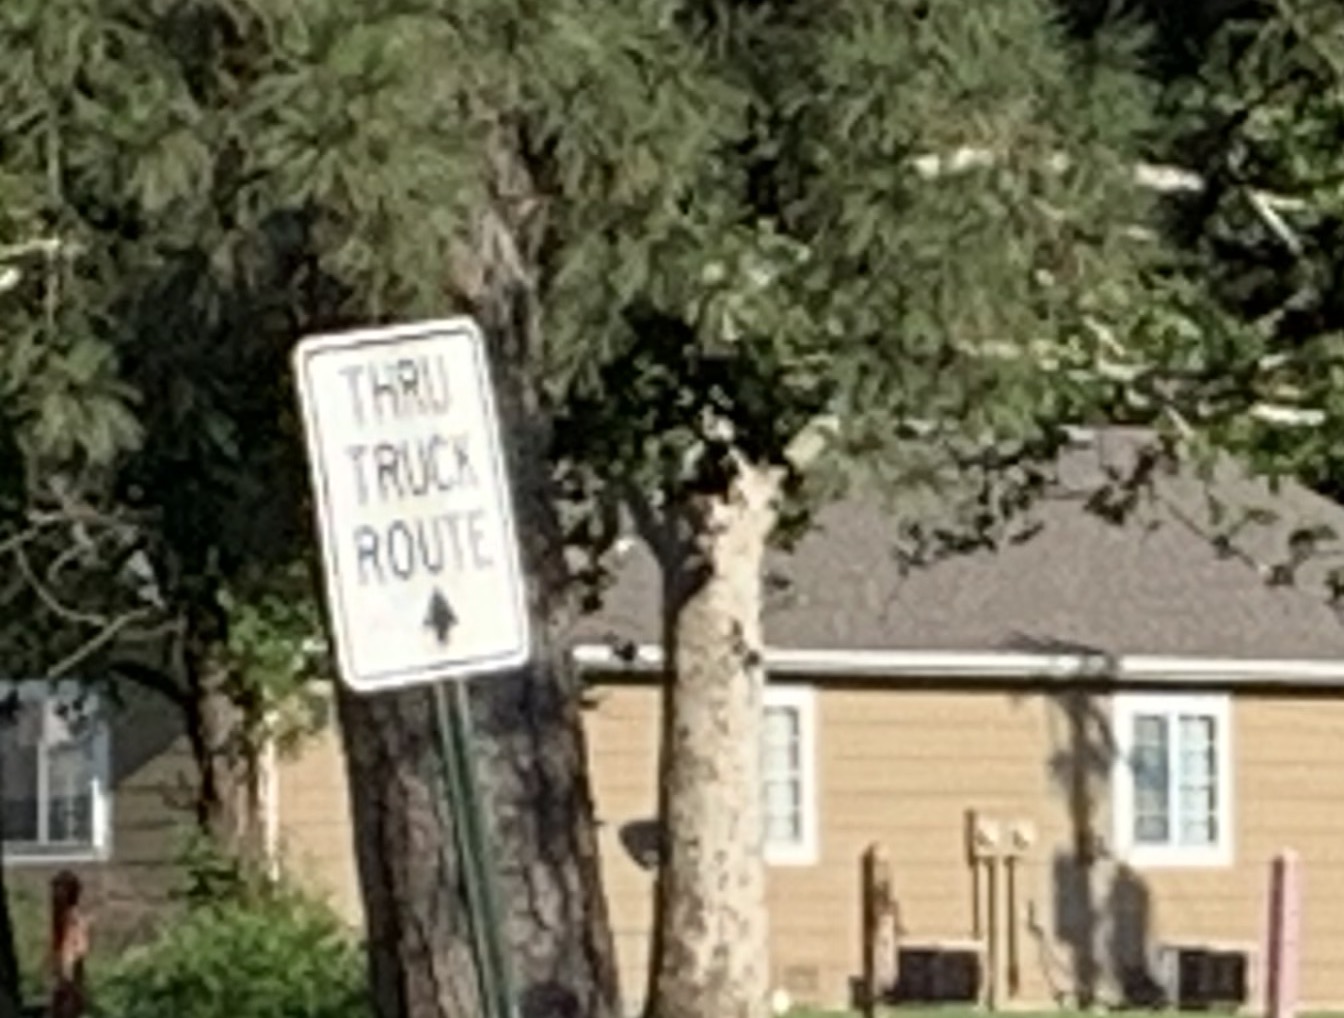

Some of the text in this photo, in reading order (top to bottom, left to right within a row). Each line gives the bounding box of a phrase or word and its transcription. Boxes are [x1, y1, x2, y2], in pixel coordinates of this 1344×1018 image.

[338, 357, 450, 427] THRU
[344, 431, 478, 505] TRUCK
[354, 509, 494, 586] ROUTE
